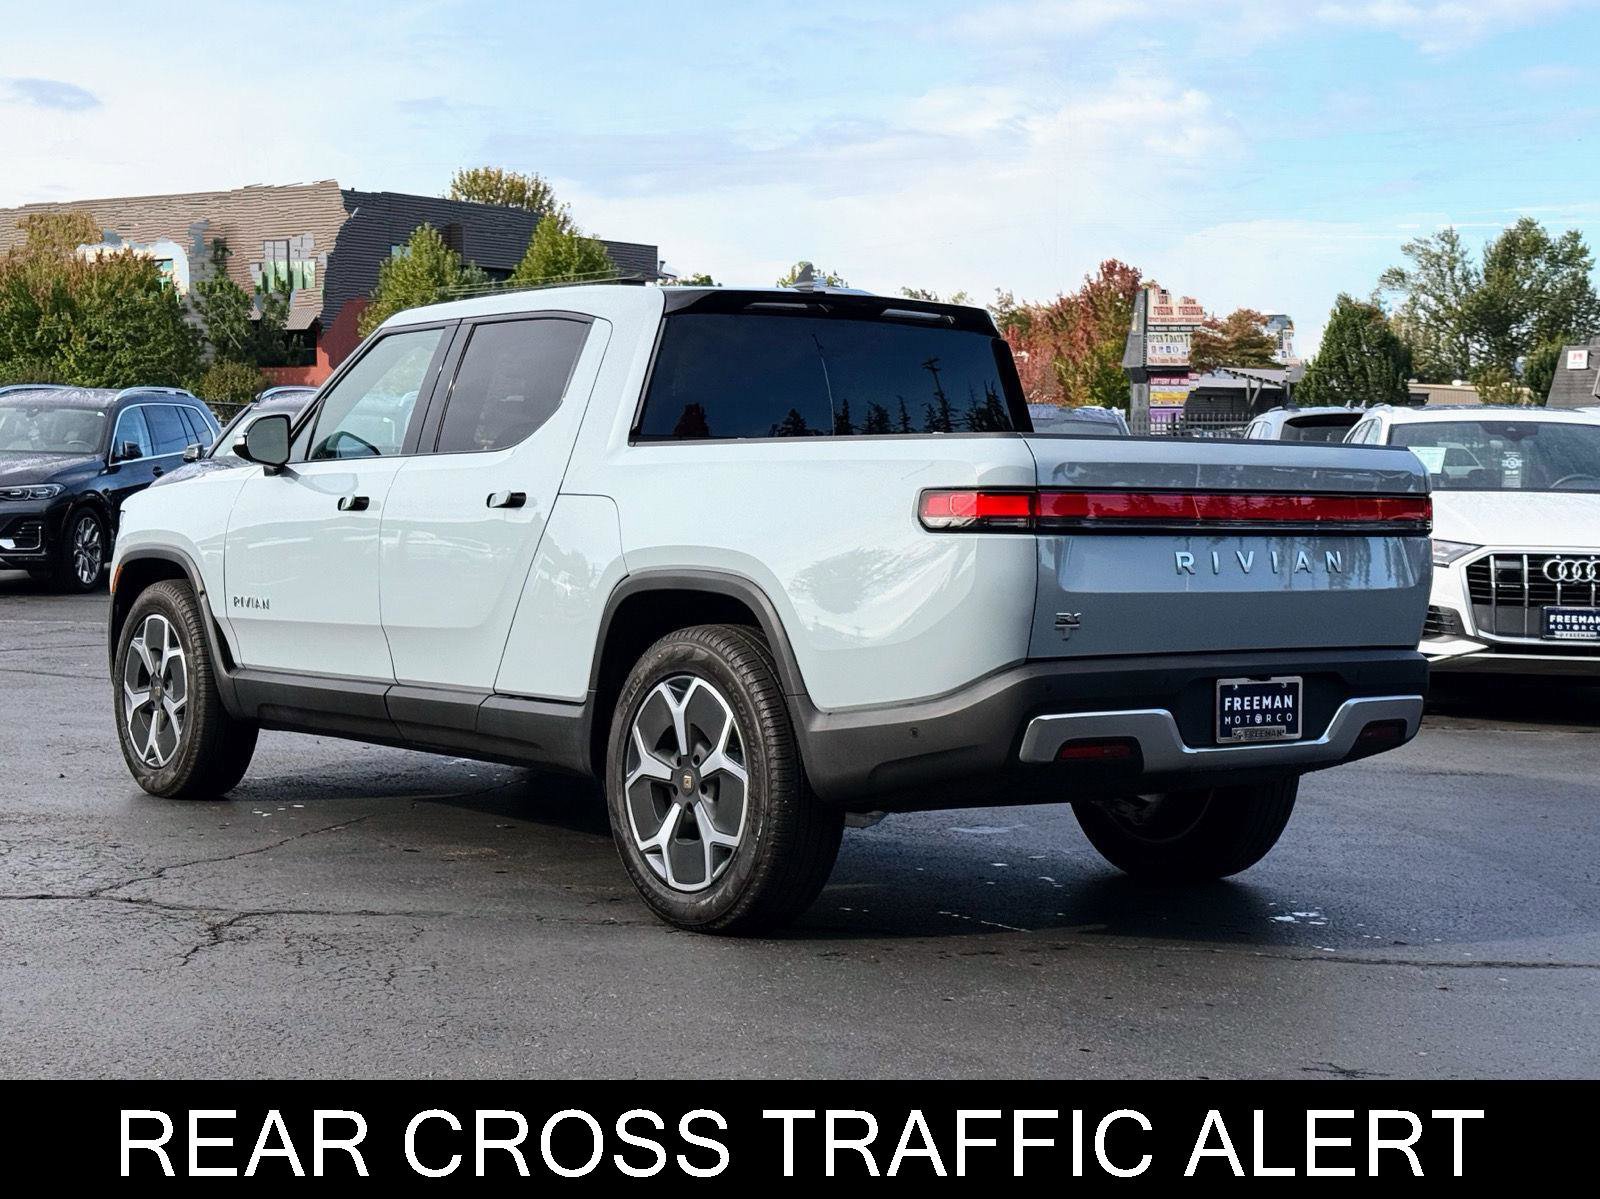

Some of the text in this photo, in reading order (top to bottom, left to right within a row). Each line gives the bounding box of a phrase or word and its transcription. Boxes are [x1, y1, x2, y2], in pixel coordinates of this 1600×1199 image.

[1174, 550, 1342, 575] RIVIAN
[233, 596, 270, 610] RIVIAN
[1224, 694, 1293, 711] FREEMAN
